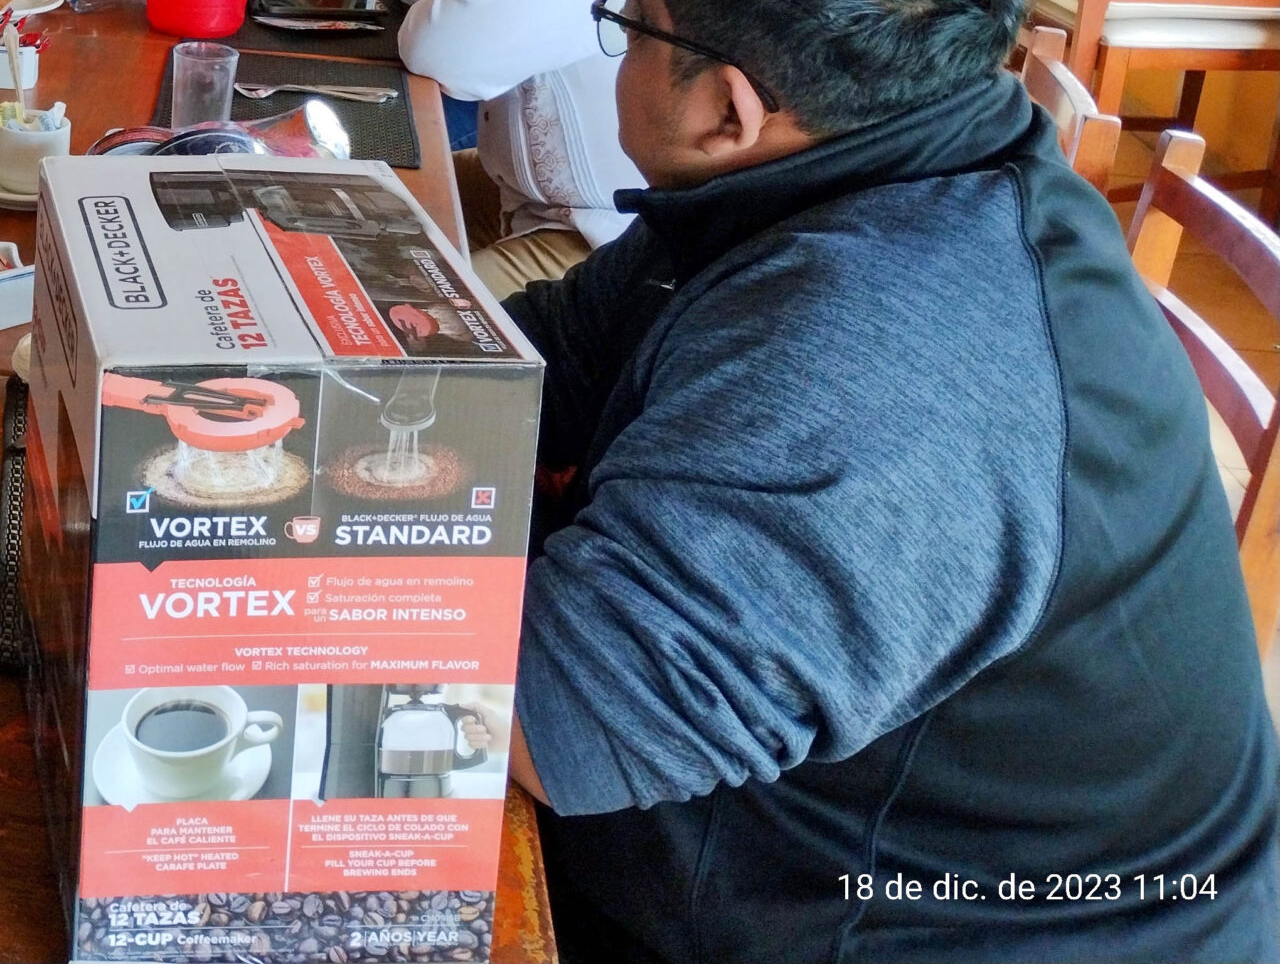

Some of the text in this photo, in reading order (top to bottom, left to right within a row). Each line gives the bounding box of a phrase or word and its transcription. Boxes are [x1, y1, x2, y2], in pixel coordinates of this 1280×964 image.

[94, 200, 150, 303] BLACK+DECKER
[421, 257, 460, 299] STANDARD
[304, 256, 372, 346] TECNOLOGÍA VORTEX
[213, 277, 268, 350] 12 TAZAS
[195, 289, 235, 350] Cafetera de
[457, 310, 493, 348] VORTEX
[420, 515, 449, 523] FLUJO
[465, 514, 492, 523] AGUA
[150, 516, 317, 538] VORTEX VS
[335, 525, 492, 545] STANDARD
[139, 537, 277, 549] FLUJO DE AGUA EN REMOLINO
[170, 574, 256, 589] TECNOLOGÍA
[326, 577, 355, 587] Flujo
[358, 577, 372, 586] de
[375, 579, 404, 588] agua
[424, 577, 474, 586] remolino
[325, 593, 442, 605] Saturación completa
[139, 590, 296, 620] VORTEX
[304, 608, 327, 618] para
[330, 609, 466, 621] SABOR INTENSO
[314, 615, 327, 623] un
[235, 646, 368, 657] VORTEX TECHNOLOGY
[138, 660, 480, 675] Optimal water flow Rich saturation for MAXIMUM FLAVOR
[176, 818, 208, 826] PLACA
[311, 815, 341, 823] LLENE
[359, 814, 385, 822] TAZA
[386, 814, 418, 822] ANTES
[421, 814, 433, 822] DE
[436, 815, 458, 823] QUE
[151, 826, 233, 836] PARA MANTENER
[299, 824, 341, 832] TERMINE
[343, 824, 355, 832] EL
[357, 824, 386, 832] CICLO
[403, 824, 445, 832] COLADO
[447, 824, 469, 832] CON
[146, 835, 236, 845] EL CAFÉ CALIENTE
[312, 833, 454, 841] EL DISPOSITIVO SNEAK-A-CUP
[201, 852, 239, 861] HEATED
[349, 850, 415, 858] SNEAK-A-CUP
[156, 862, 227, 871] CARAFE PLATE
[347, 859, 374, 867] YOUR
[376, 859, 396, 867] CUP
[398, 859, 437, 867] BEFORE
[343, 868, 417, 877] BREWING ENDS
[108, 901, 187, 912] Cafetera de
[108, 912, 201, 927] 12 TAZAS
[108, 933, 258, 947] 12-CUP Coffeemaker
[350, 929, 459, 947] 2 AÑOS YEAR
